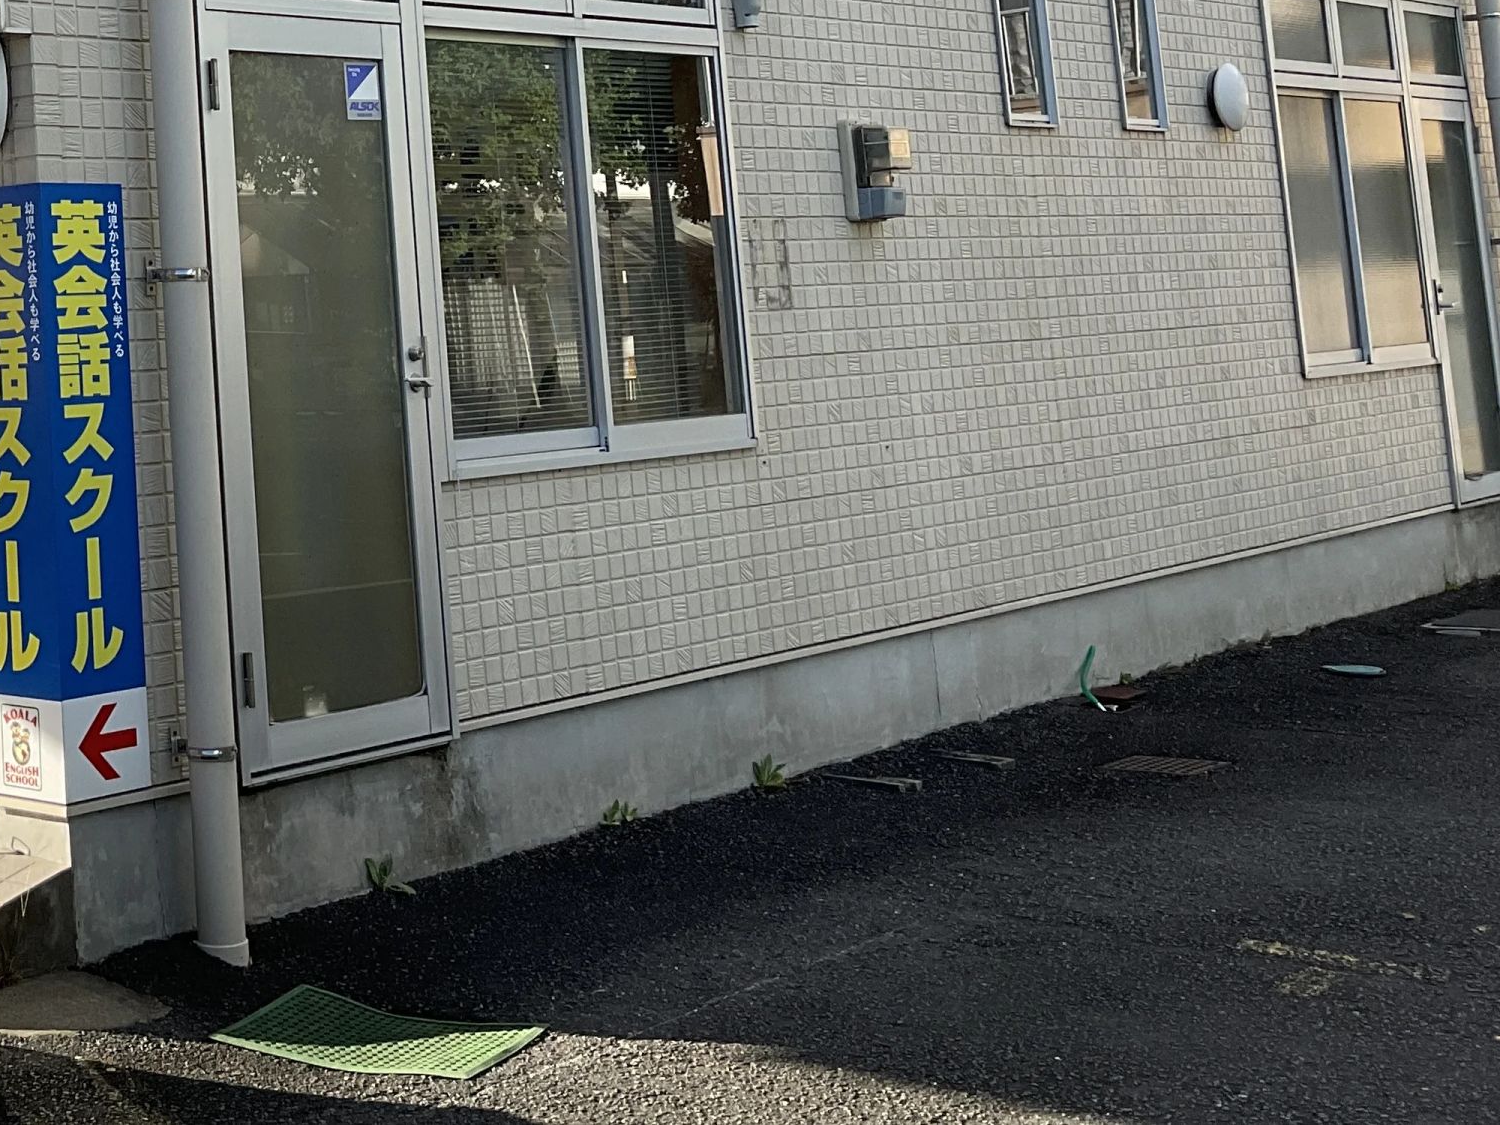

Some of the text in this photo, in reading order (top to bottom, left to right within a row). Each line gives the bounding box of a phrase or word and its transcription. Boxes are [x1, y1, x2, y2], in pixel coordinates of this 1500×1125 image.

[349, 101, 380, 112] ALSOK
[24, 201, 41, 361] 幼児から社会人も学べる
[106, 201, 125, 357] 幼児から社会人も学べる
[50, 199, 124, 673] 英会話スクール
[3, 709, 37, 728] KOALA
[4, 762, 40, 777] ENGLISH
[5, 773, 40, 787] SCHOOL
